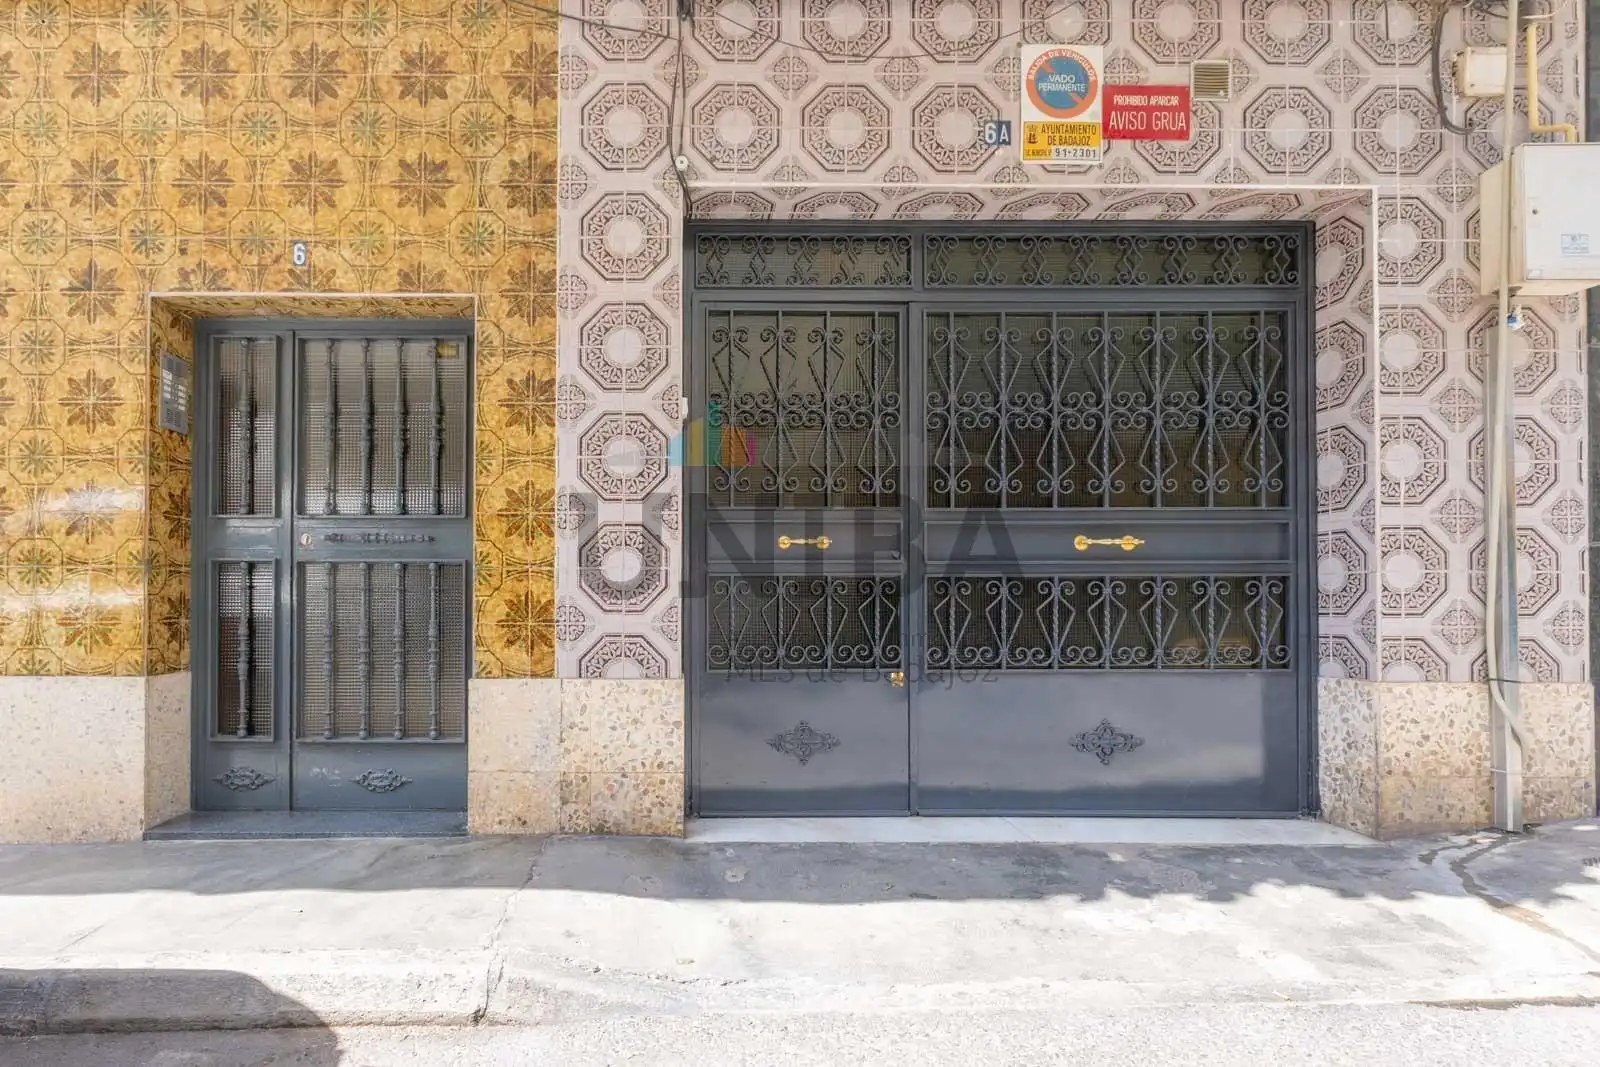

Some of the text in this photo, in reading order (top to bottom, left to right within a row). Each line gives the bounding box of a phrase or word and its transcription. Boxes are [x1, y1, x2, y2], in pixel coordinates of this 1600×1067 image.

[1027, 54, 1049, 81] SALIDA
[1048, 50, 1060, 58] DE
[1048, 74, 1076, 83] VADO
[1038, 82, 1086, 92] PERMANENTE
[1113, 95, 1179, 106] PROHIBIDO APARCAR
[1109, 111, 1187, 131] AVISO GRUA
[984, 122, 1009, 143] 6A
[1041, 124, 1097, 135] AYUNTAMIENTO
[1047, 135, 1091, 146] DE BADAJOZ
[293, 243, 306, 265] 6
